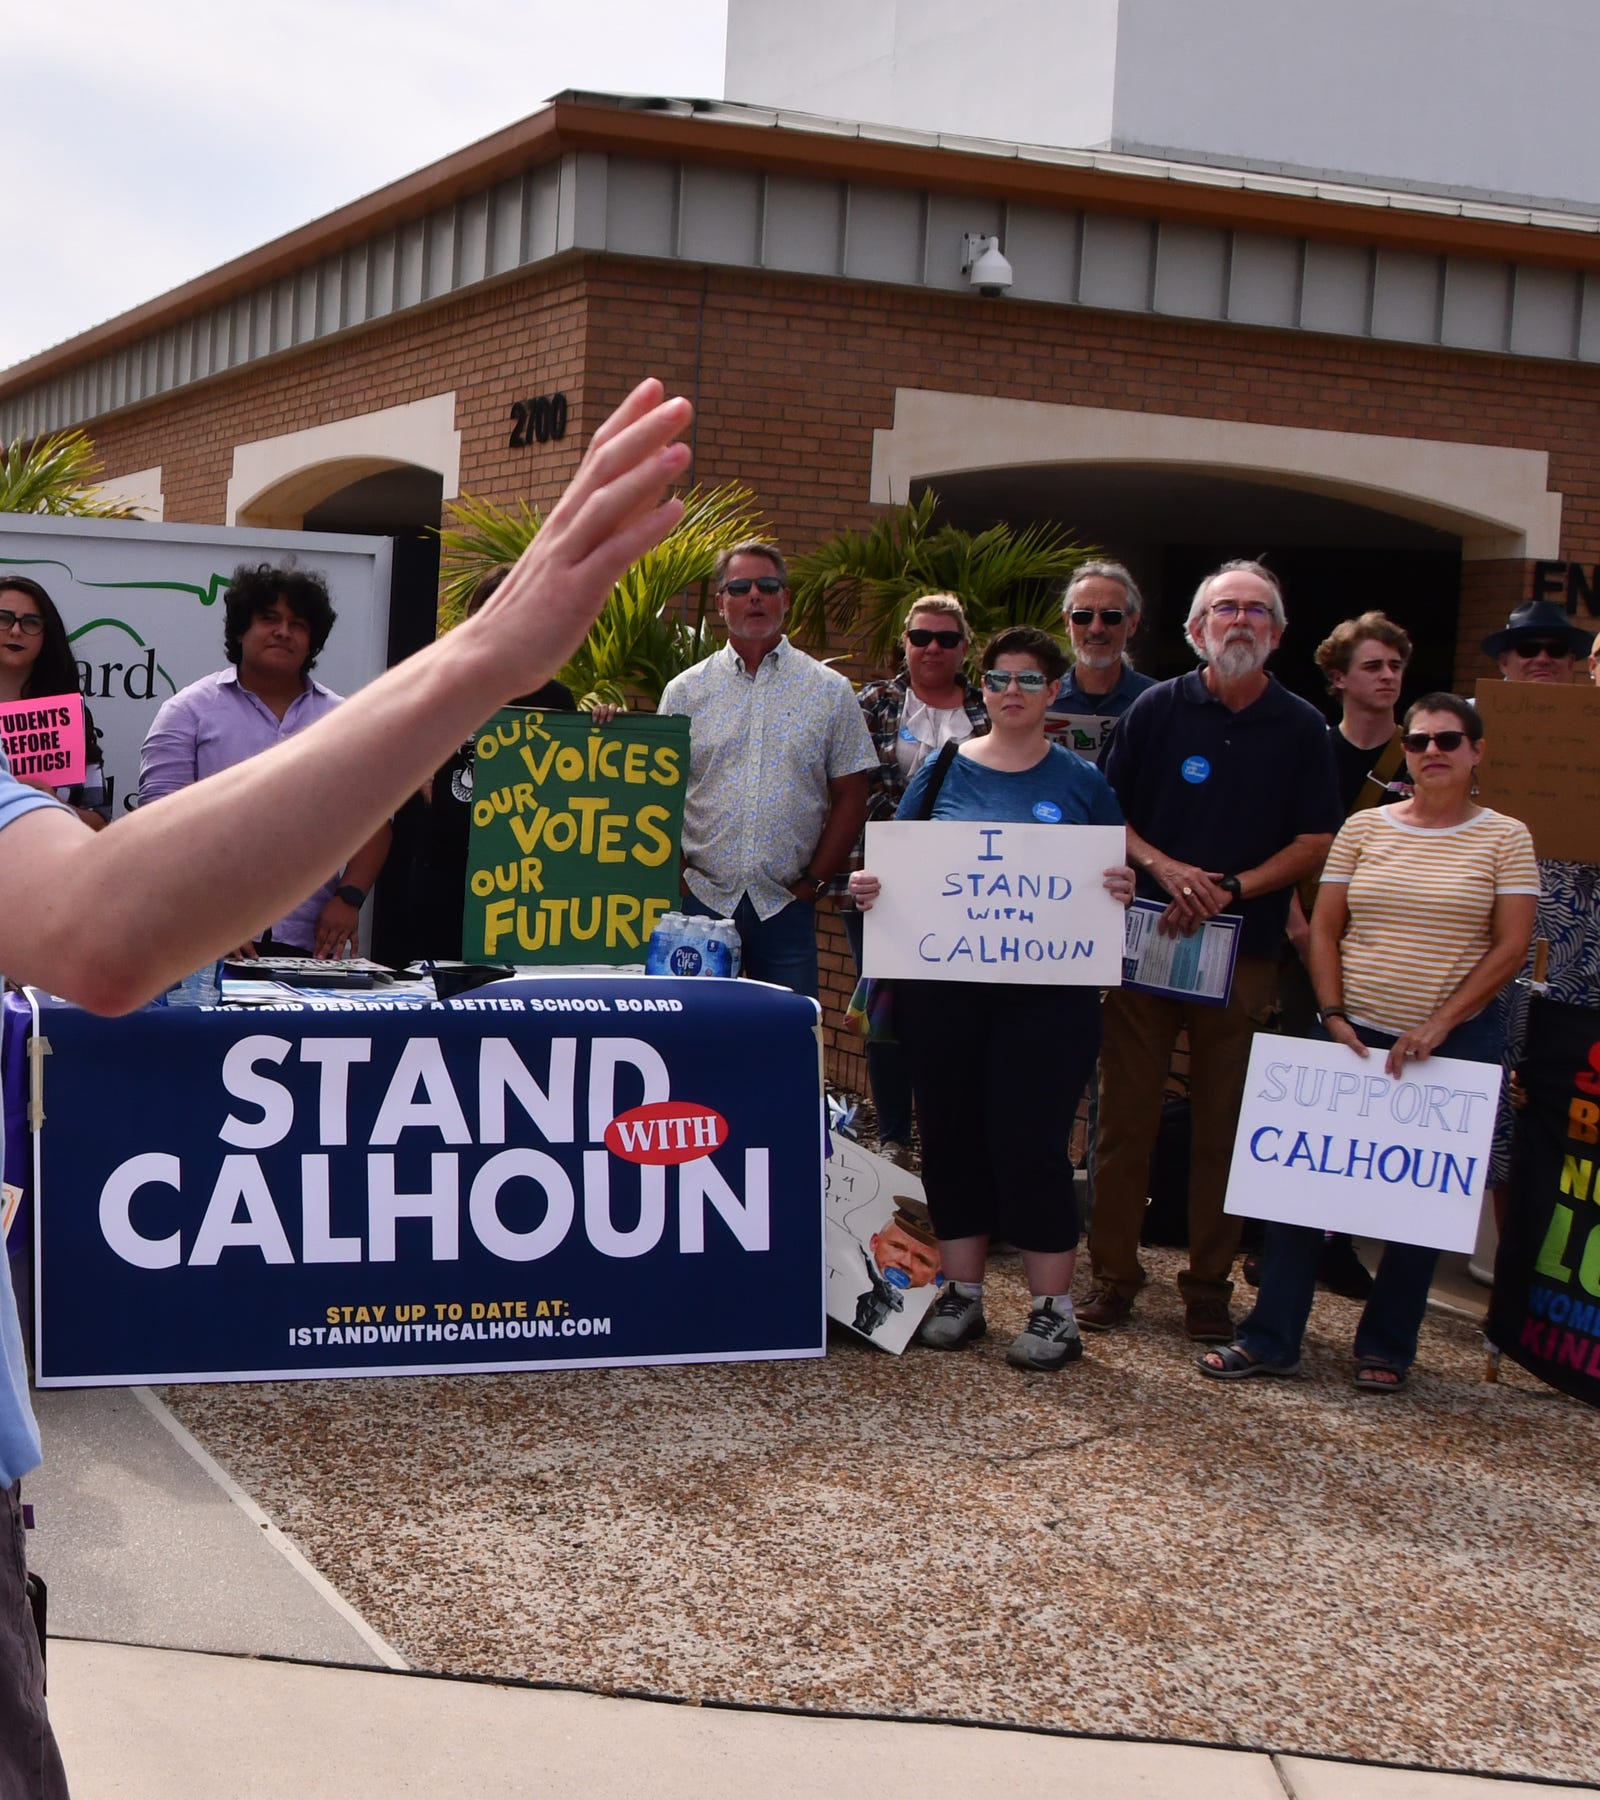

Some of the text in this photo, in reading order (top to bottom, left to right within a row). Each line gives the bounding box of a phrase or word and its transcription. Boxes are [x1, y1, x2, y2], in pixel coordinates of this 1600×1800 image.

[509, 392, 567, 448] 2700
[477, 712, 551, 760] OUR
[9, 751, 71, 777] LITICS!
[519, 727, 680, 786] VOICES
[473, 783, 538, 827] OUR
[509, 797, 672, 867] VOTES
[978, 829, 1003, 861] I
[471, 857, 544, 896] OUR
[942, 873, 1072, 900] STAND
[676, 949, 698, 961] Pure
[677, 957, 695, 969] Life
[918, 933, 1094, 963] CALHOUN
[430, 1001, 445, 1011] A
[450, 998, 526, 1012] BETTER
[532, 998, 610, 1012] SCHOOL
[615, 999, 683, 1012] BOARD
[218, 1034, 670, 1149] STAND
[1258, 1062, 1488, 1133] SUPPORT
[615, 1116, 718, 1152] WITH
[1250, 1126, 1478, 1196] CALHOUN
[99, 1147, 770, 1269] CALHOUN
[326, 1300, 570, 1324] STAY UP TO DATE AT:
[289, 1317, 612, 1346] ISTANDWITHCALHOUN.COM
